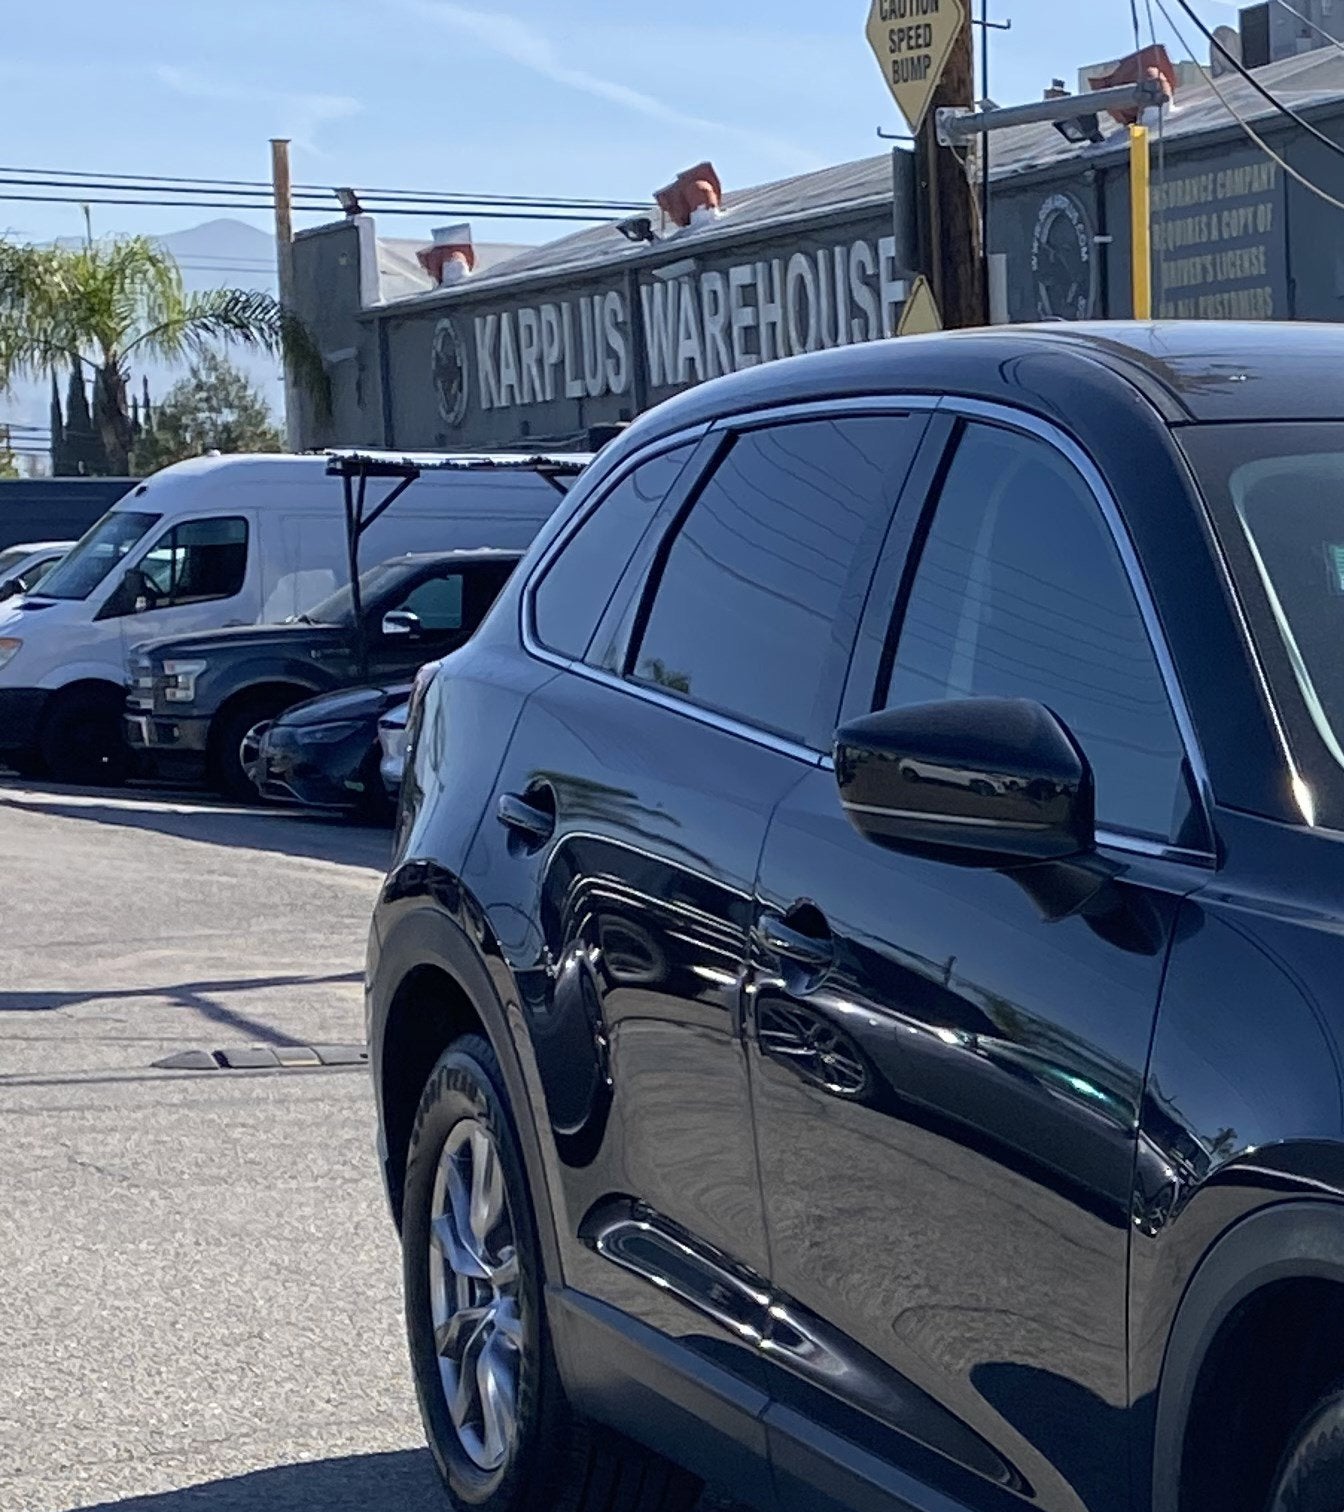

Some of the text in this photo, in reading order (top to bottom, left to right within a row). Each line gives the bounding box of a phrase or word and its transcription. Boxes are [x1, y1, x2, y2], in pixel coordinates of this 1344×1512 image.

[888, 23, 932, 54] SPEED
[891, 54, 932, 85] BUMP
[1215, 245, 1267, 281] LICENSE
[475, 291, 632, 409] KARPLUS
